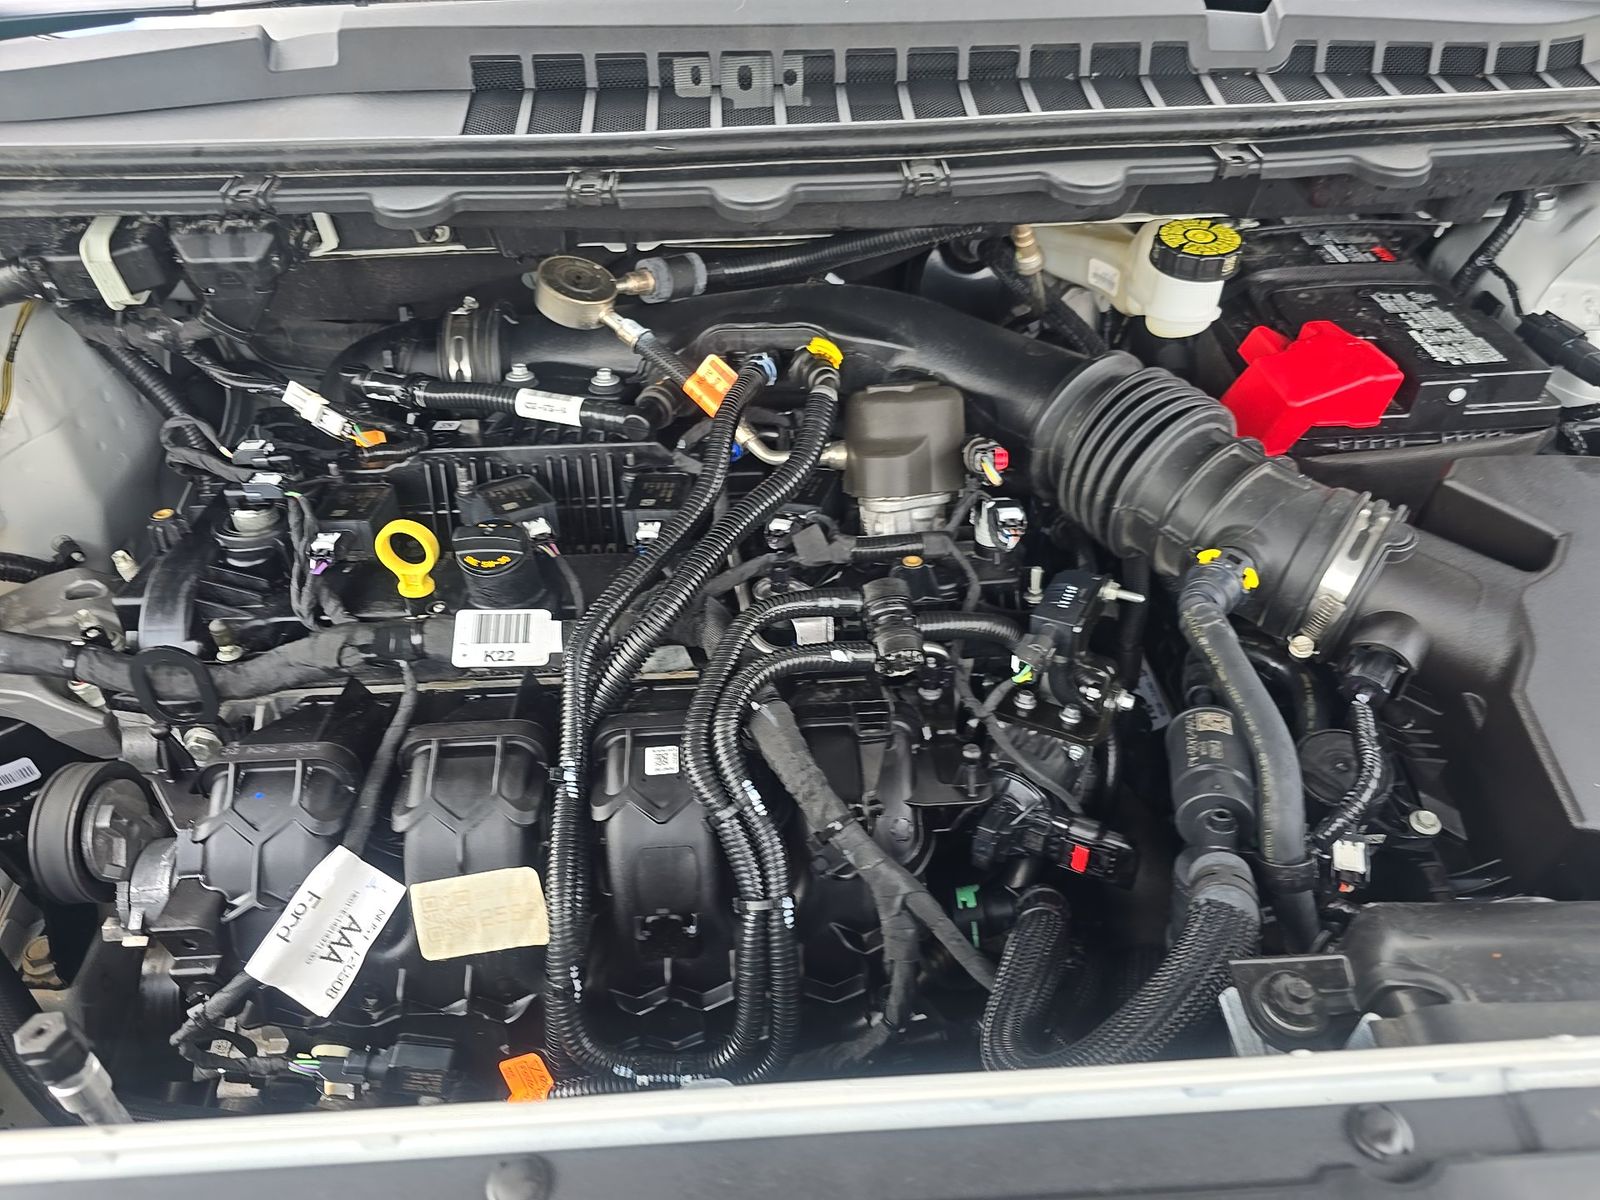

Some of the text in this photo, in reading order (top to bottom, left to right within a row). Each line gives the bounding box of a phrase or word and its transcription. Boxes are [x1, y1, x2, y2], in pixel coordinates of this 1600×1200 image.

[484, 650, 515, 662] K22
[276, 890, 324, 944] Ford
[320, 914, 362, 965] AAA
